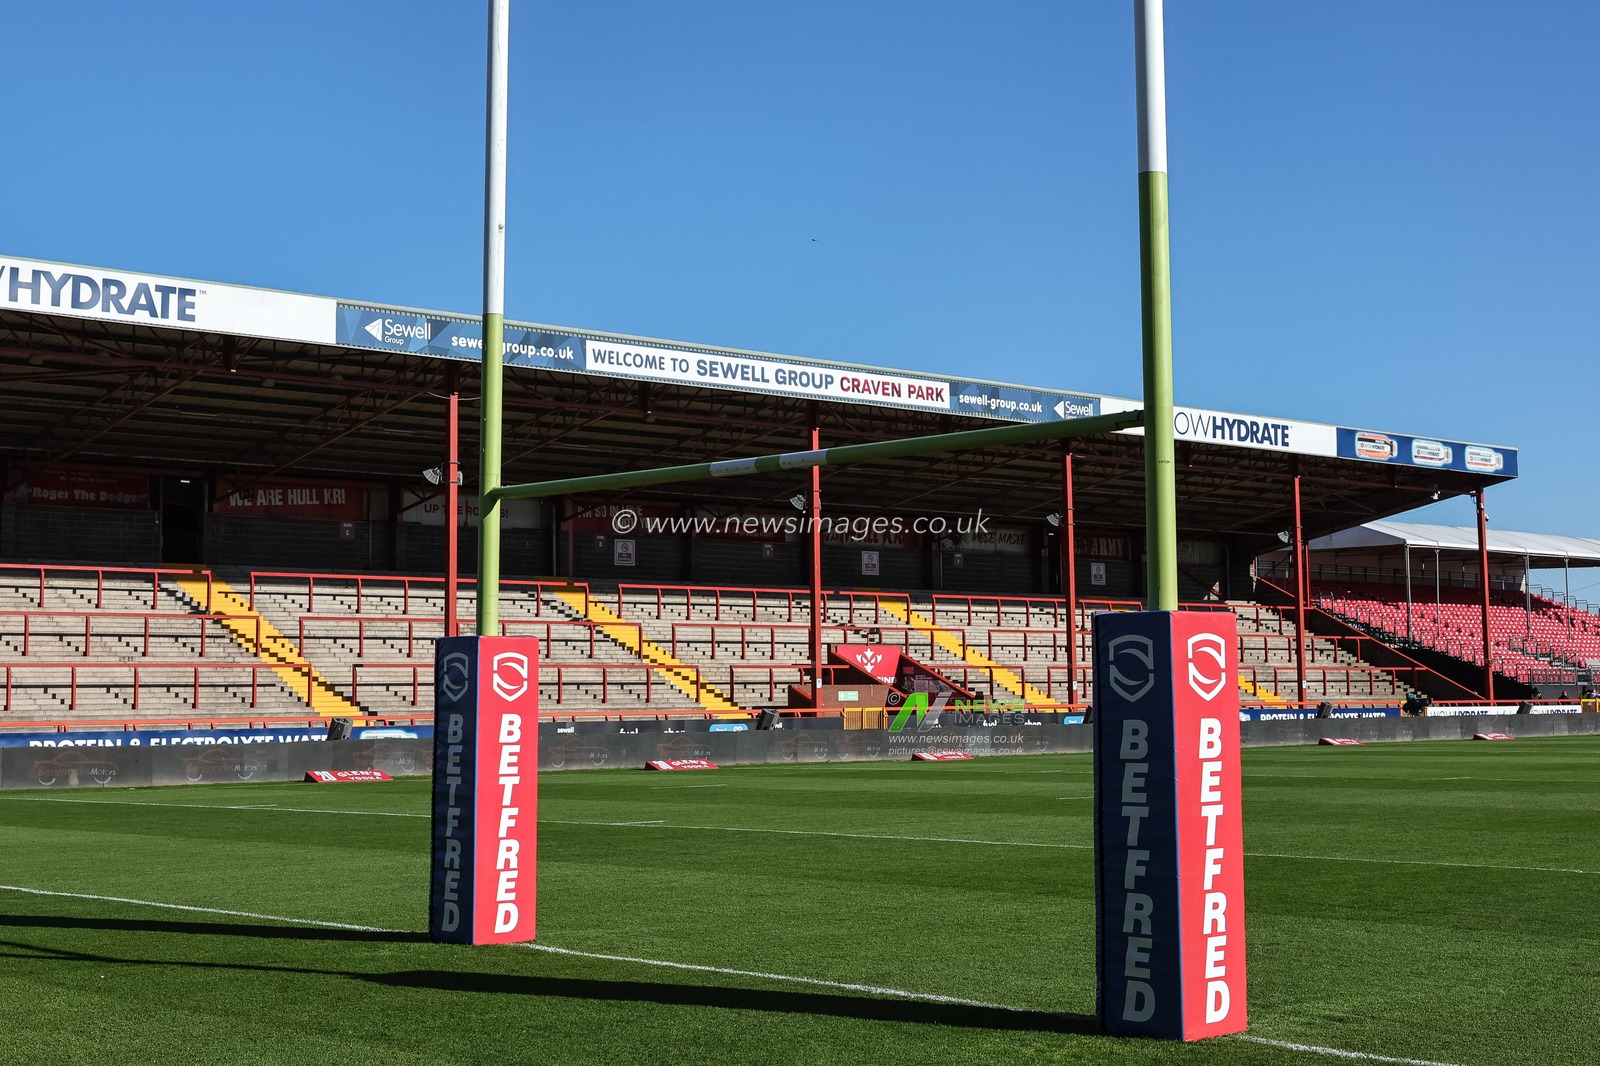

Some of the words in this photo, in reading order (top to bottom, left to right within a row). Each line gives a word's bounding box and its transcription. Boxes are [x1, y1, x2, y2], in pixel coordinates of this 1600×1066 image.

[0, 264, 197, 323] HYDRATE
[385, 318, 431, 341] Sewell
[385, 335, 405, 346] Group
[592, 347, 666, 371] WELCOME
[671, 357, 690, 374] TO
[696, 359, 770, 384] SEWELL
[774, 368, 835, 390] GROUP
[840, 376, 902, 398] CRAVEN
[907, 384, 946, 403] PARK
[958, 393, 1043, 414] sewell-group.co.uk
[1065, 400, 1093, 417] Sewell
[1174, 411, 1290, 448] OWHYDRATE
[73, 488, 97, 500] The
[256, 488, 283, 507] ARE
[287, 488, 320, 506] HULL
[424, 503, 439, 514] UP
[595, 505, 607, 518] SO
[1091, 537, 1124, 557] ARMY
[441, 713, 464, 933] BETFRED
[493, 713, 523, 935] BETFRED
[1119, 719, 1156, 1023] BETFRED
[1198, 717, 1231, 1026] BETFRED
